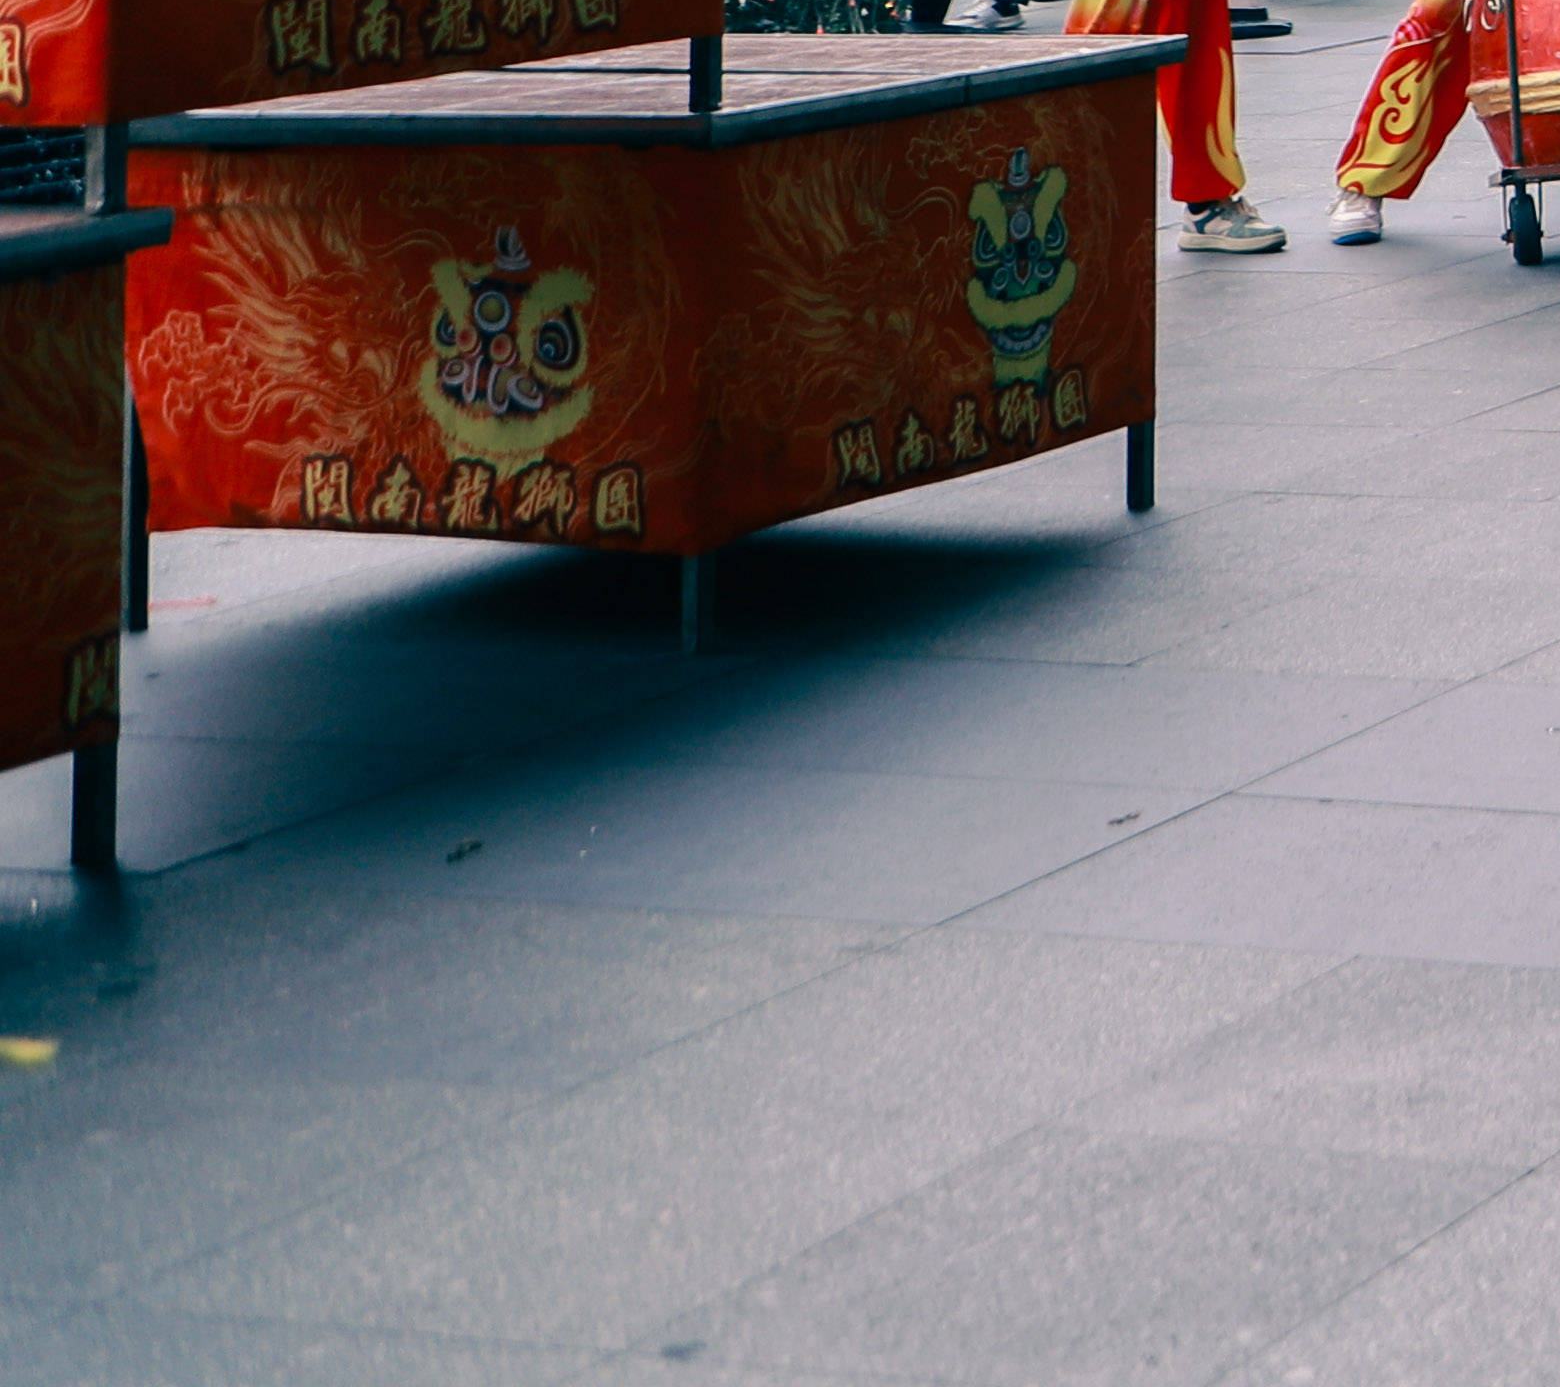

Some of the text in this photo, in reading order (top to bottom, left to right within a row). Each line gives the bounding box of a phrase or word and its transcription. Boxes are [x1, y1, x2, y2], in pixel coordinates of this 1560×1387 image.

[836, 368, 1088, 487] 閩南龍獅團
[302, 456, 643, 539] 閩南龍獅團
